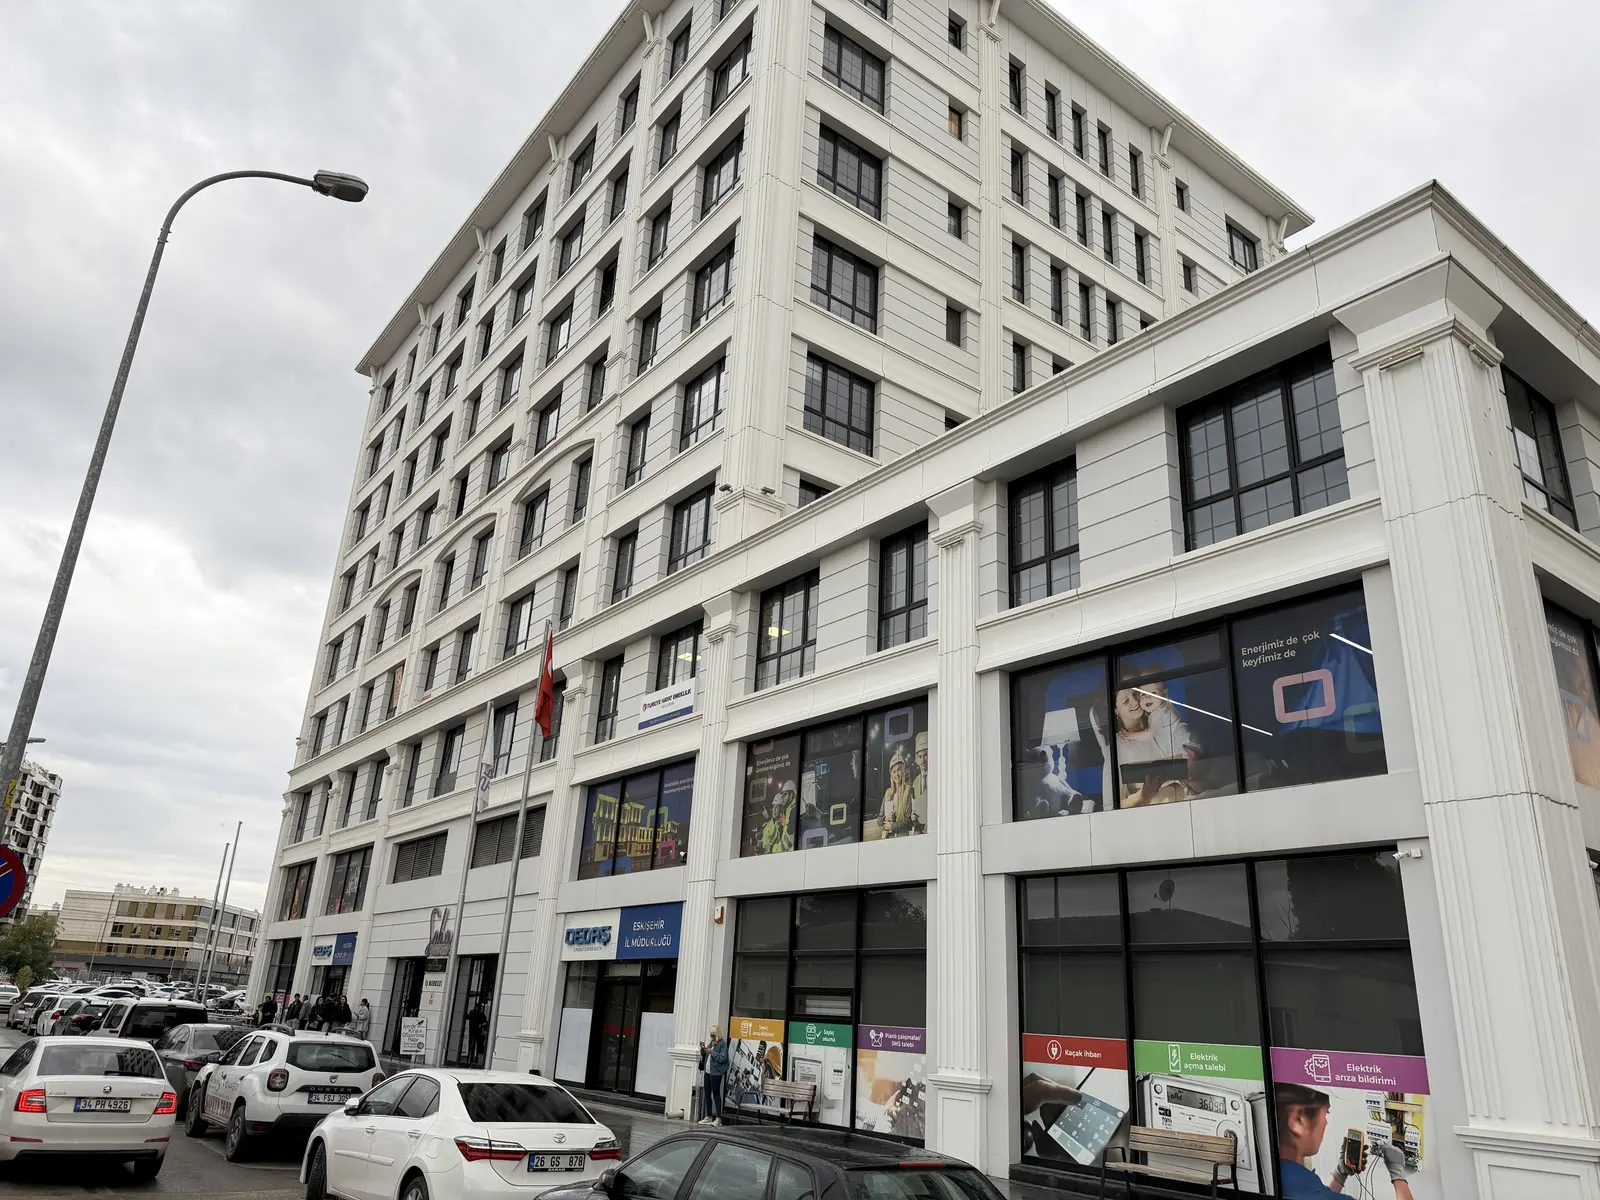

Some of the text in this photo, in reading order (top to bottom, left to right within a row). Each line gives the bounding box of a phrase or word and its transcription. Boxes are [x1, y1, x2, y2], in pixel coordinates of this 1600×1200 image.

[1241, 631, 1320, 656] Enerjimiz de çok
[1242, 649, 1296, 667] keyfimiz de
[633, 917, 665, 931] ESKİŞEHİR
[624, 934, 672, 948] İL MÜDÜRLÜĞÜ
[1064, 1049, 1102, 1059] Kaçak ihbarı
[1190, 1052, 1219, 1062] Elektrik
[1183, 1062, 1226, 1072] açma talebi
[1346, 1063, 1382, 1074] Elektrik
[1335, 1074, 1397, 1085] arıza bildirimi
[312, 1093, 320, 1102] 34
[323, 1094, 335, 1102] FSJ
[81, 1100, 129, 1110] 34 PH 4926
[535, 1155, 583, 1168] 26 GS 878
